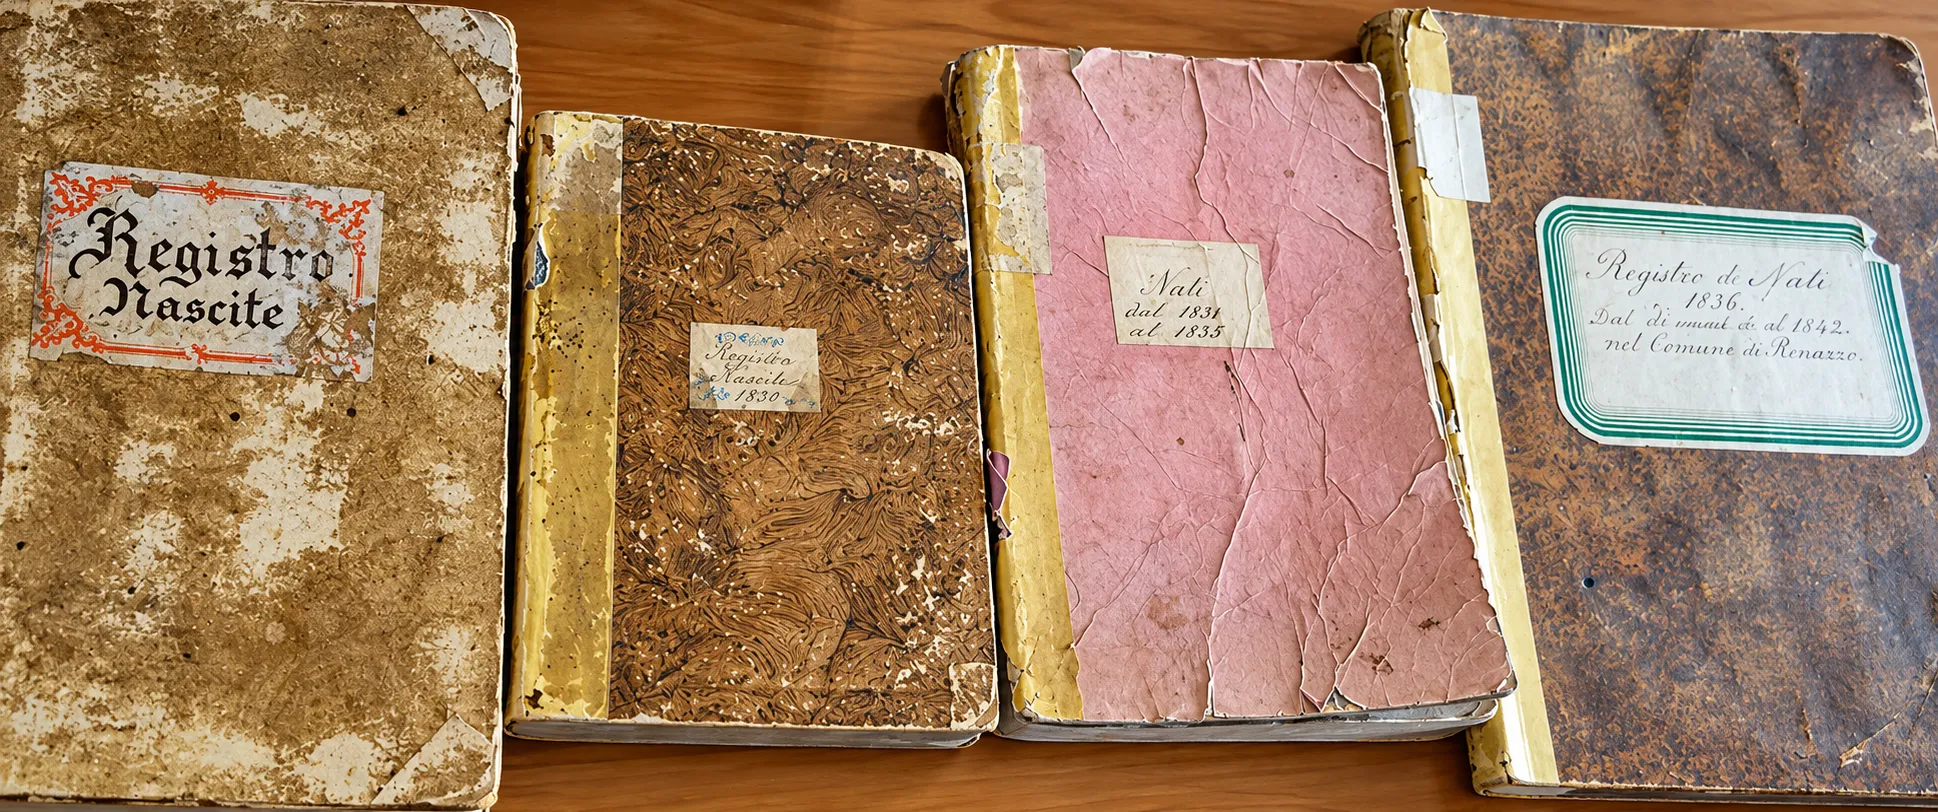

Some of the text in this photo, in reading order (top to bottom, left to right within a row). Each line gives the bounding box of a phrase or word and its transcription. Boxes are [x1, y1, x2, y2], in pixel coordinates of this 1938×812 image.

[68, 203, 335, 288] Registro
[1140, 267, 1209, 297] Nati
[1585, 248, 1832, 302] Registro de Nati
[98, 277, 285, 331] Nascite
[1125, 302, 1222, 319] dal 1831
[1685, 292, 1745, 311] 1836.
[1129, 322, 1226, 339] al 1835
[1588, 306, 1634, 326] Dal
[1764, 313, 1789, 332] al
[1792, 317, 1850, 336] 1842.
[1604, 332, 1863, 361] nel Comune di Renazzo.
[734, 389, 780, 403] 1830
